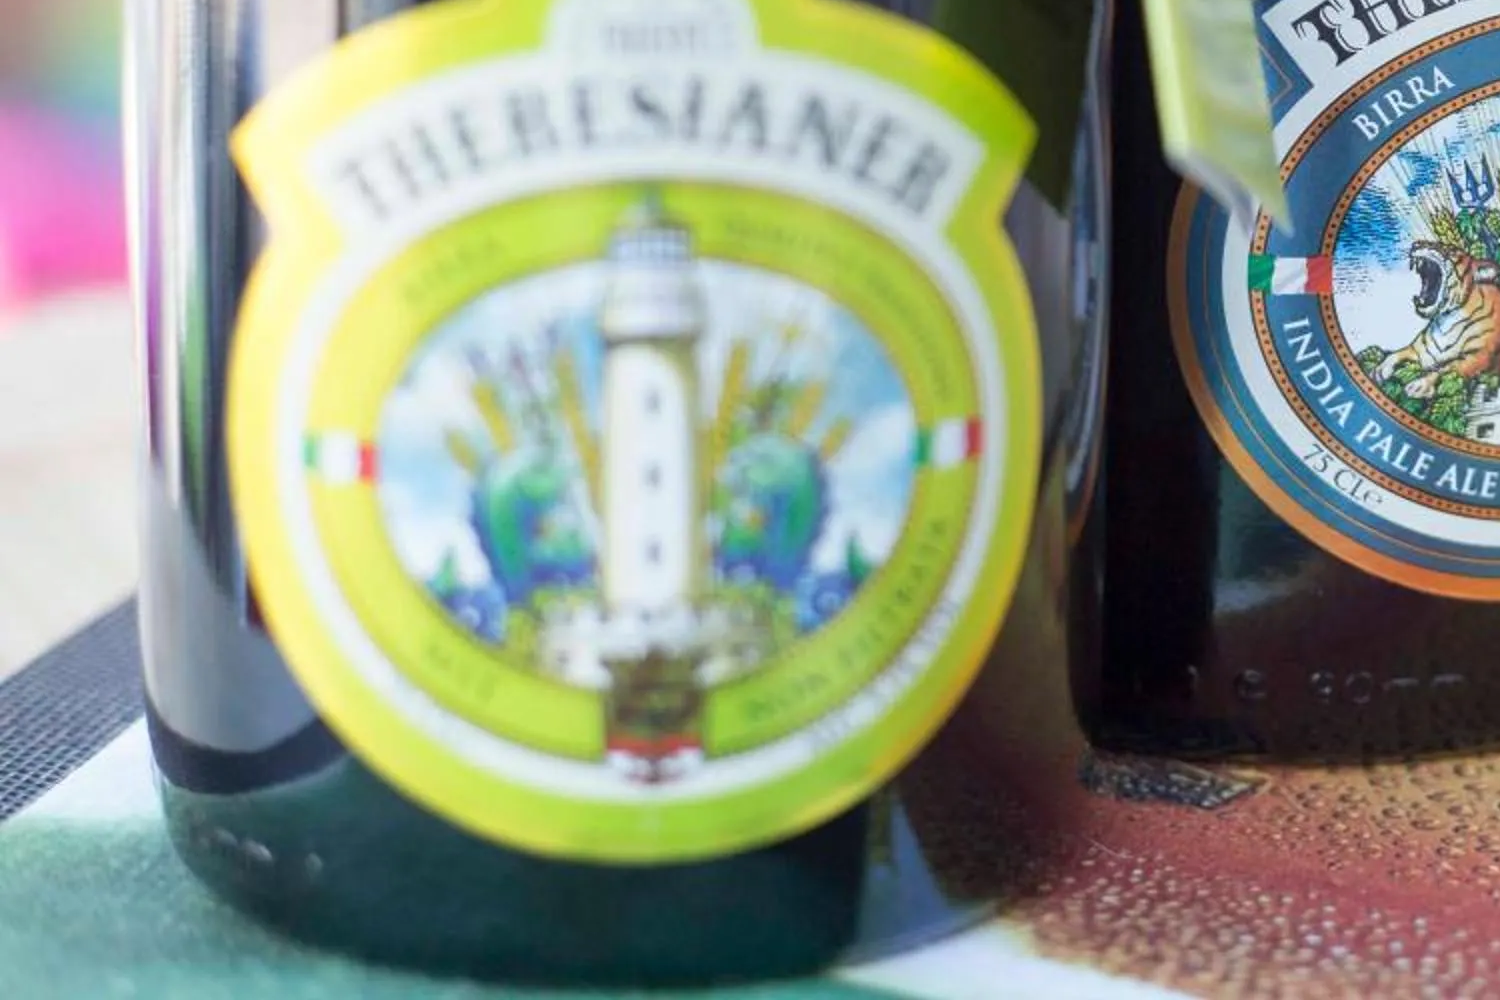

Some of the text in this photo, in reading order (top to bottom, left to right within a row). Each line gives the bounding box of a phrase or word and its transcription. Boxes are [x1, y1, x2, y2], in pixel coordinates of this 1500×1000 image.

[337, 75, 953, 222] THERESIANER
[1352, 64, 1456, 142] BIRRA
[1281, 316, 1364, 429] INDIA
[1358, 418, 1436, 483] PALE
[1302, 443, 1335, 473] 75
